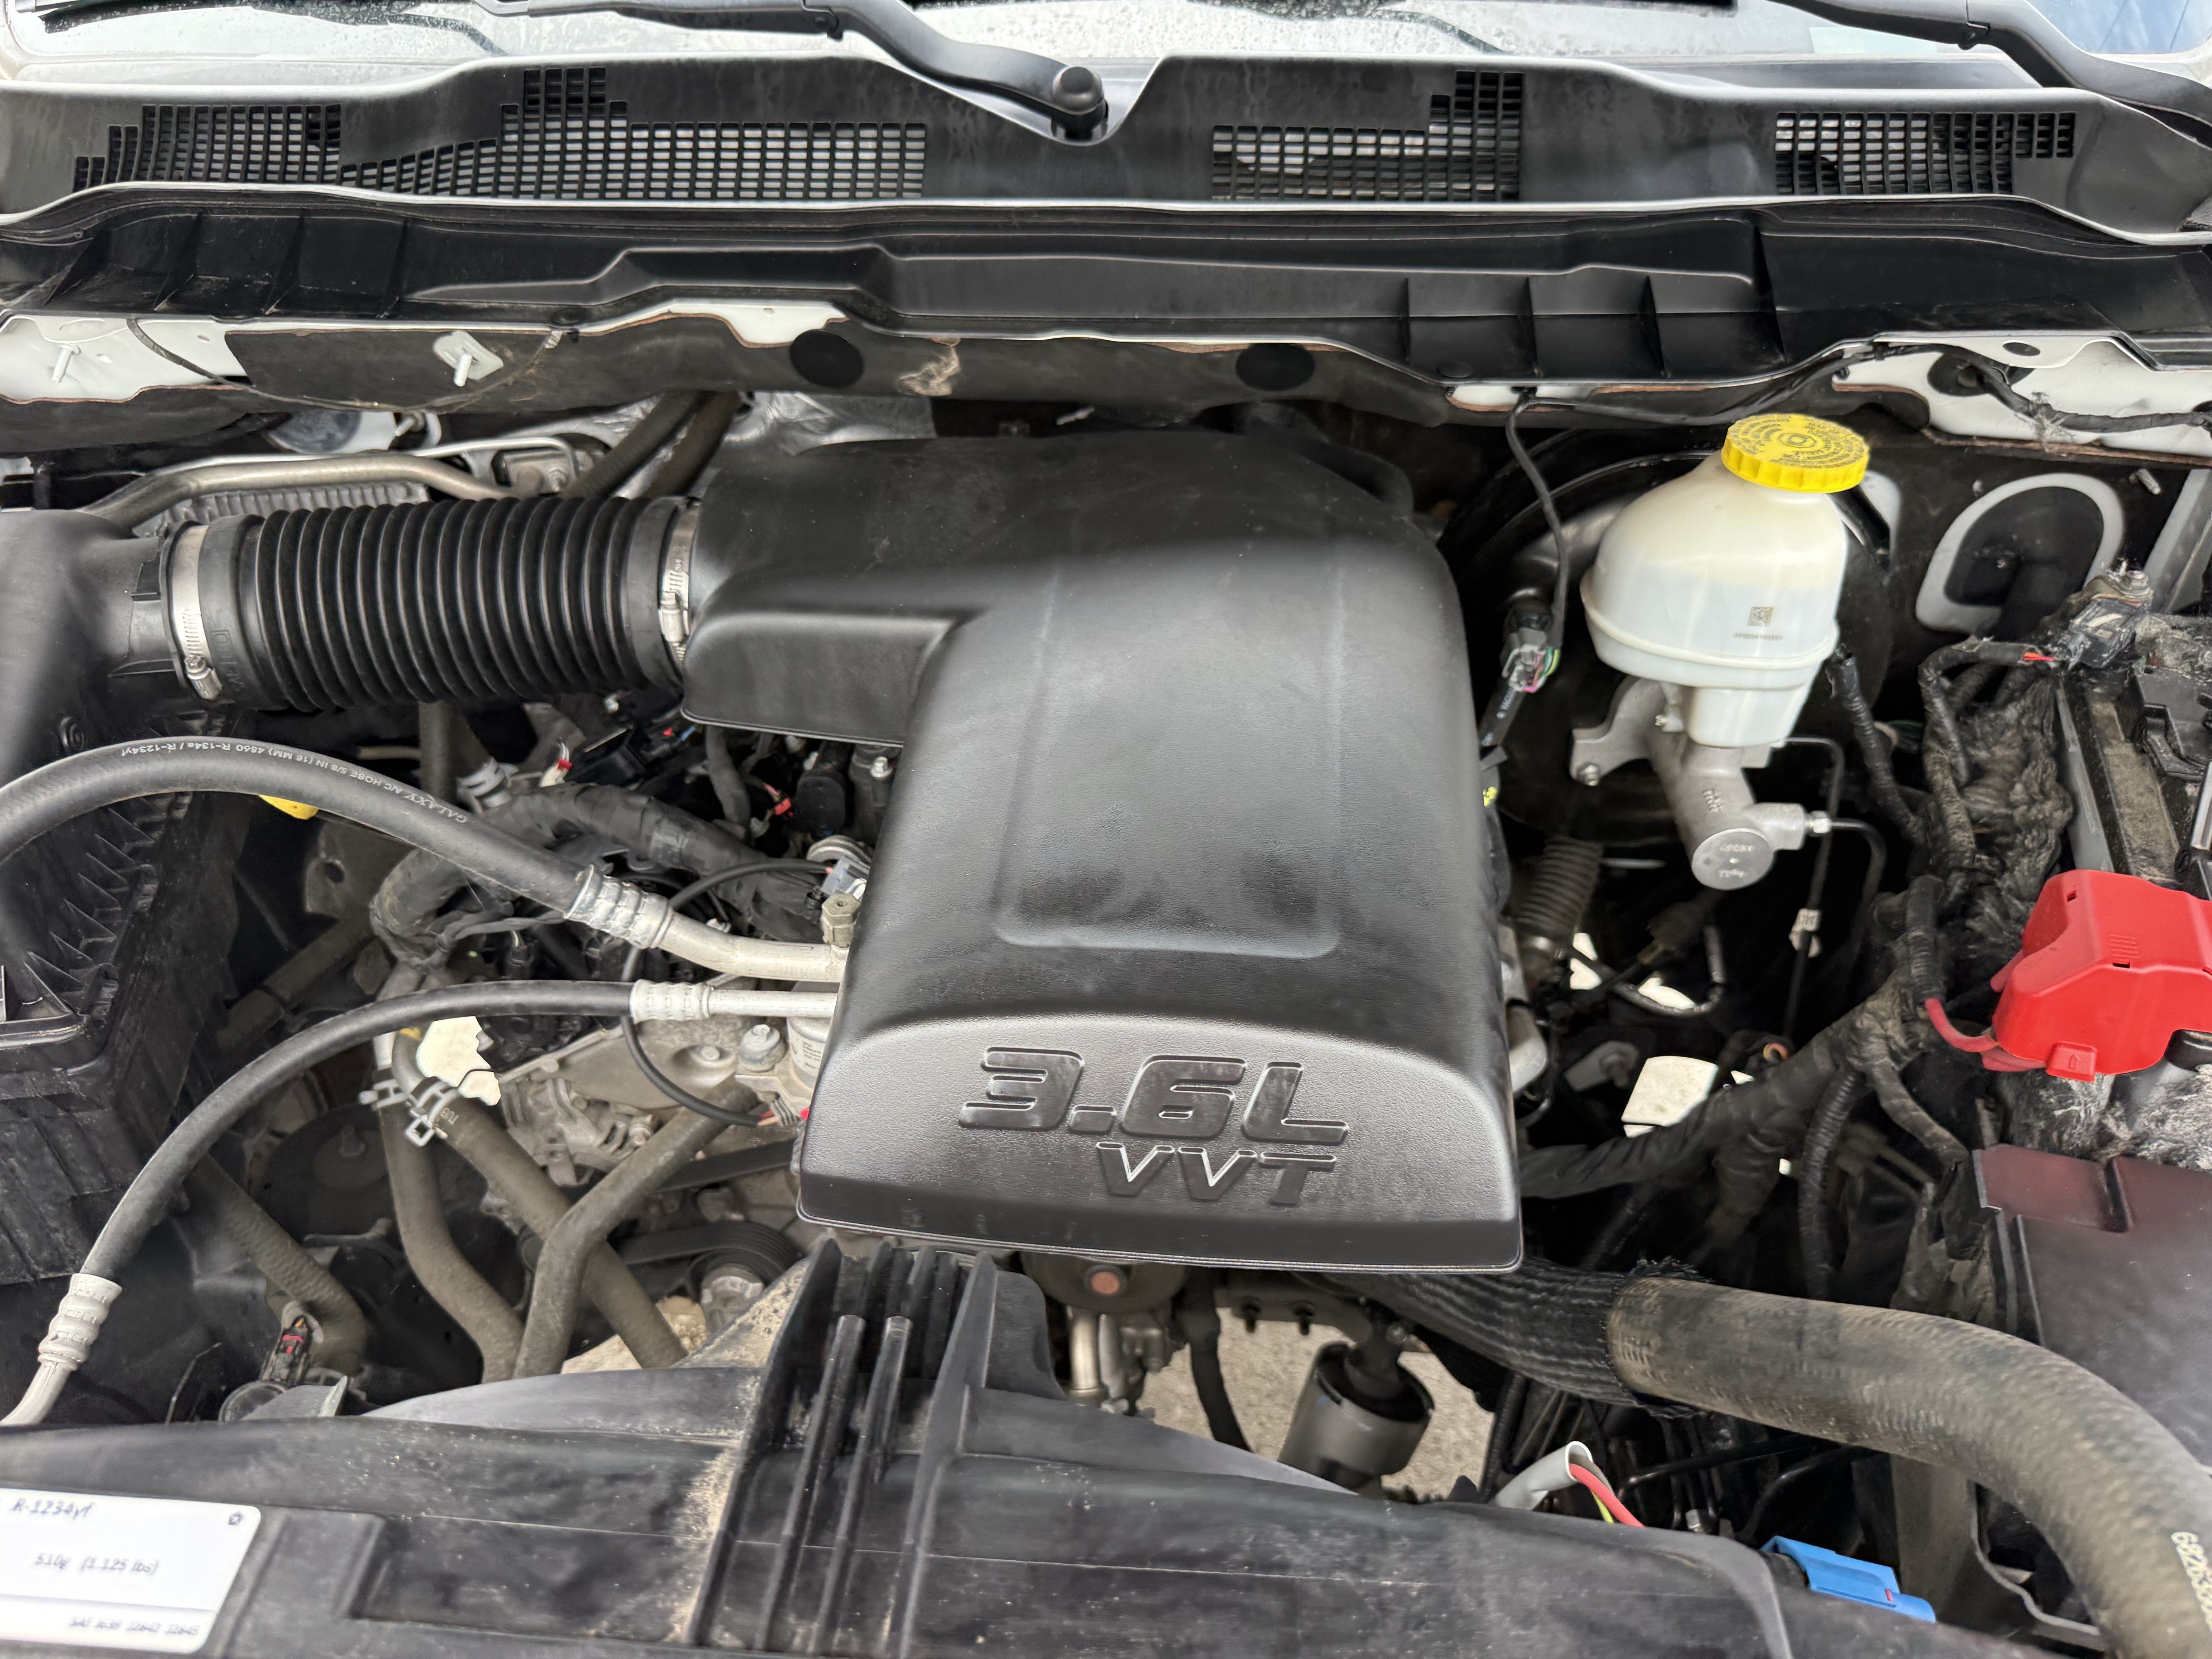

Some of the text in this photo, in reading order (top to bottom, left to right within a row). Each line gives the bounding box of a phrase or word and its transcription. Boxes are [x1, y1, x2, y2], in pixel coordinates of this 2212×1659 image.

[121, 742, 177, 757] R-1234yf
[188, 742, 231, 750] R-134a
[236, 744, 266, 754] 4860
[269, 749, 293, 760] MM)
[295, 754, 314, 765] (16
[316, 759, 329, 769] IN
[330, 764, 348, 774] 5/8
[350, 770, 382, 787] HOSE
[384, 782, 404, 794] A/C
[404, 793, 468, 824] GALAXY
[958, 1047, 1350, 1145] 3.6L
[1096, 1142, 1337, 1205] VVT
[11, 1498, 96, 1520] R-1234yf
[131, 1558, 160, 1576] lbs)
